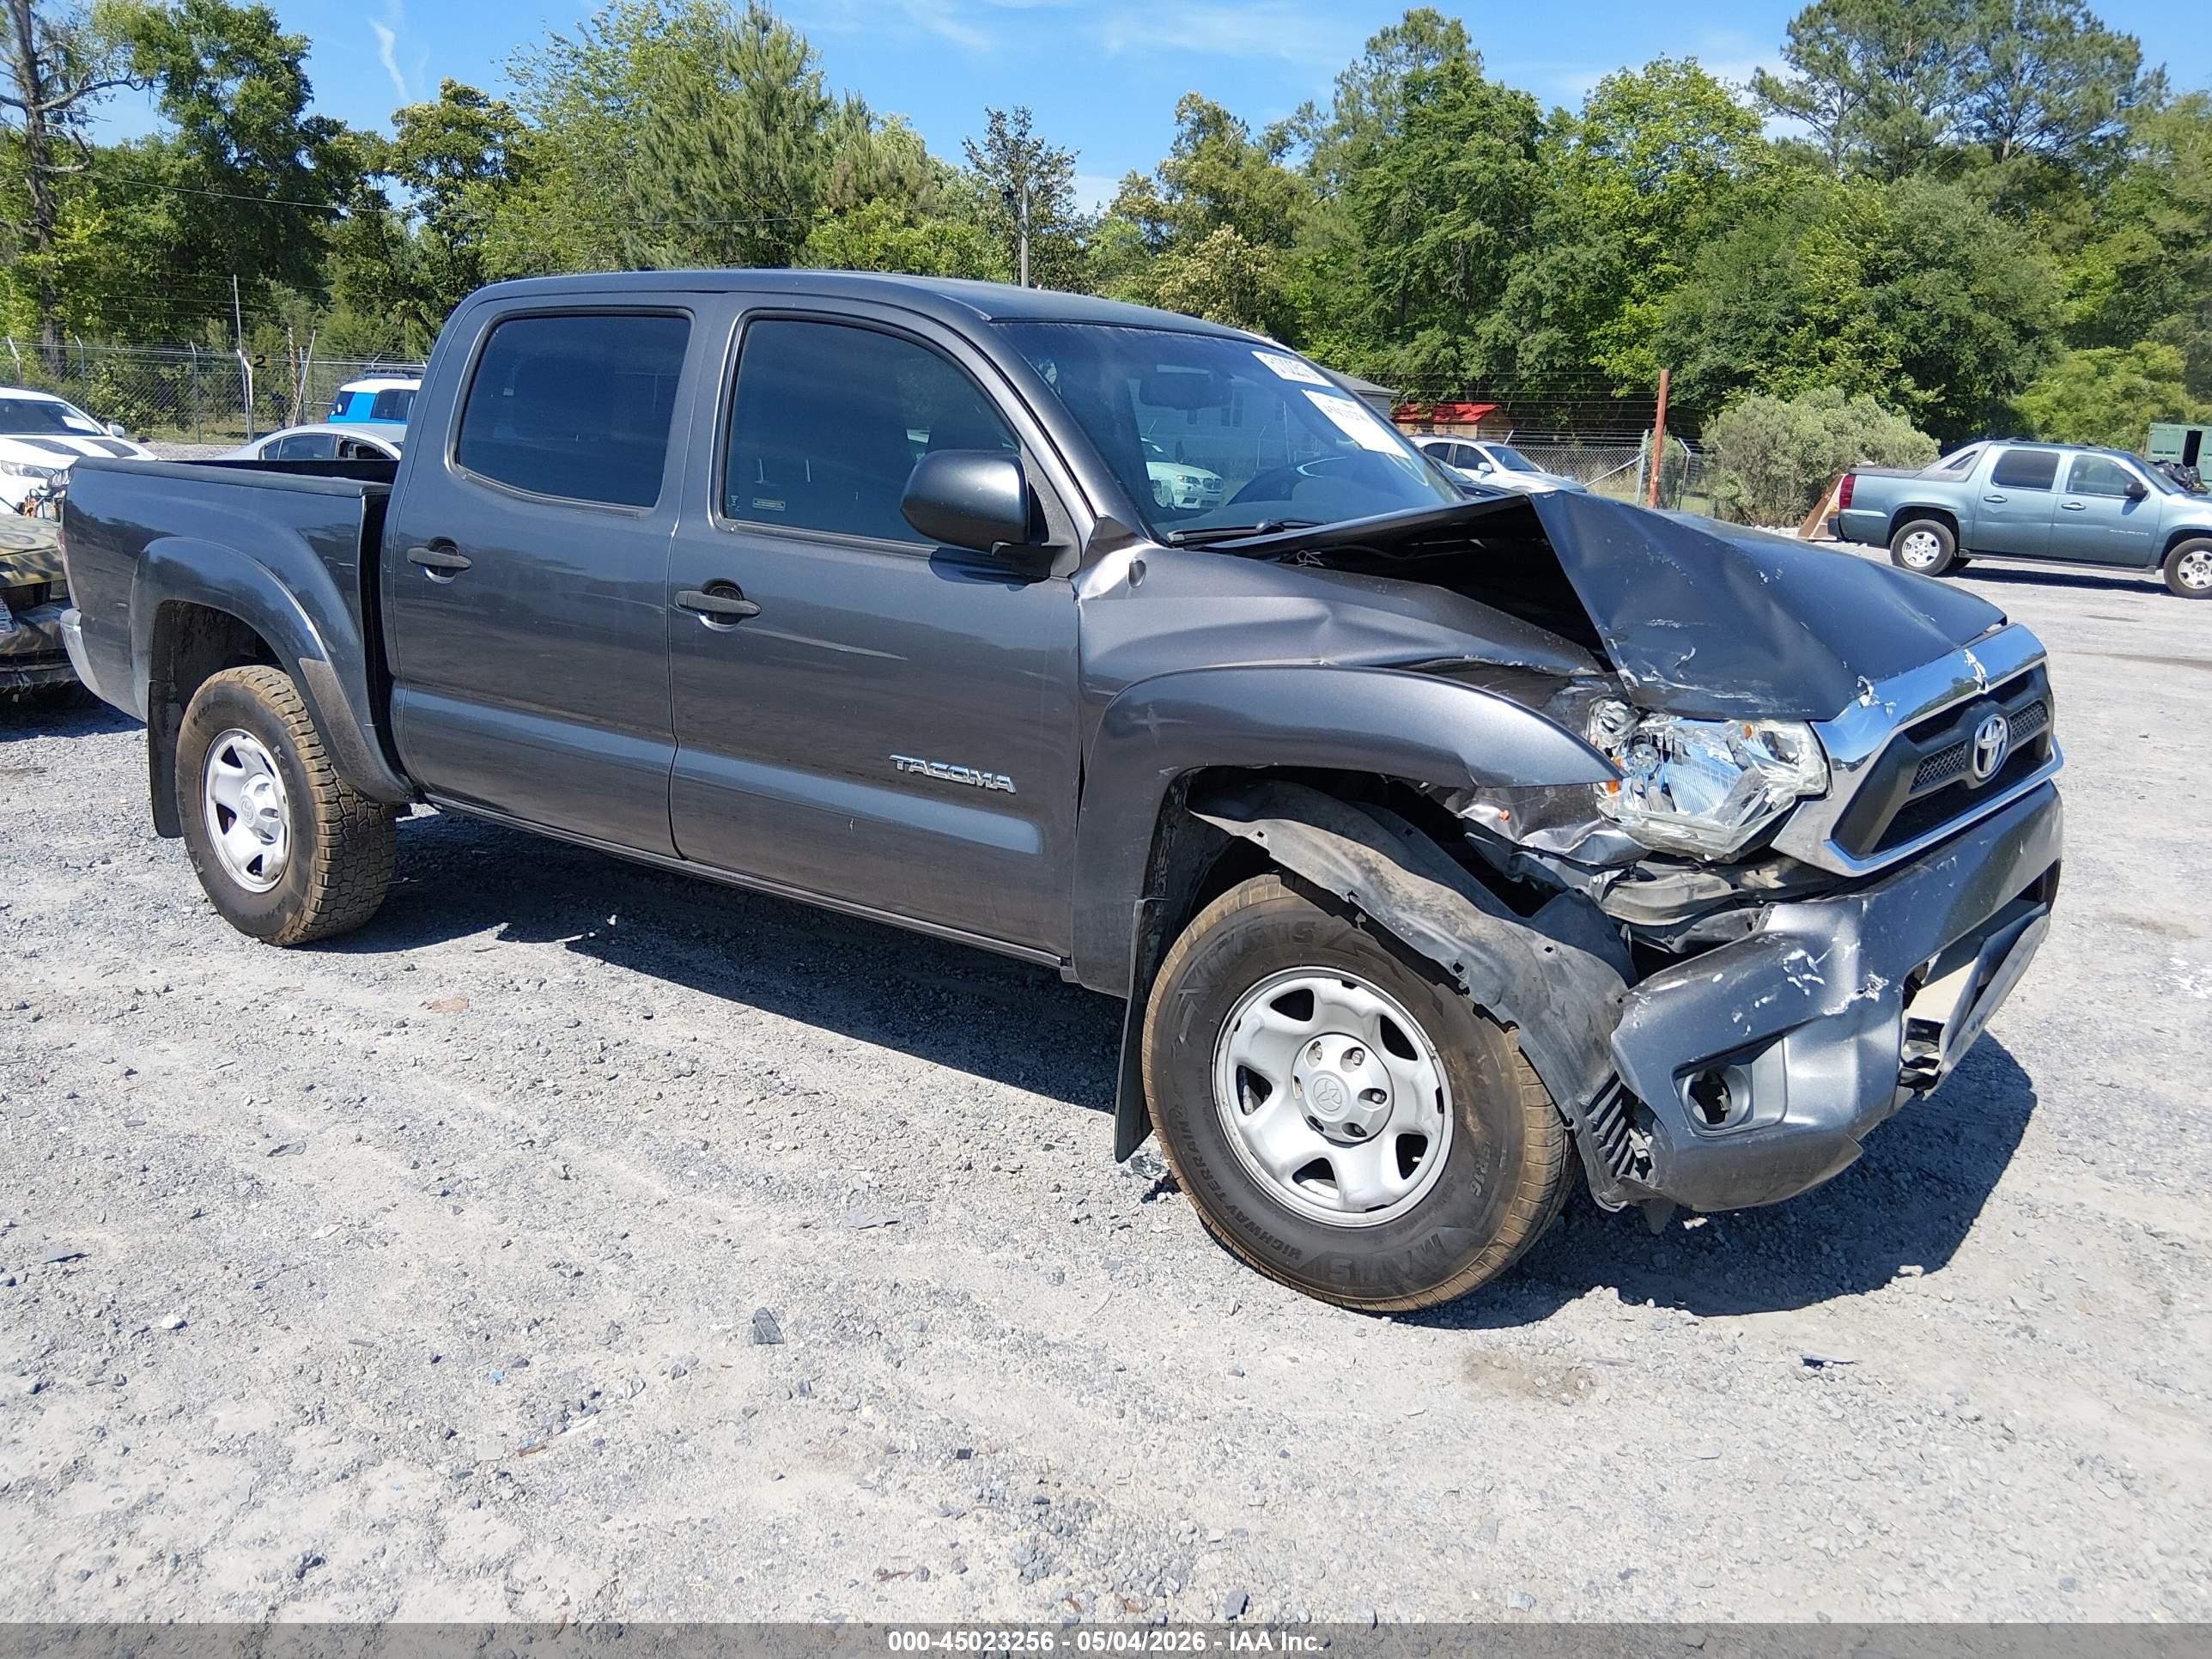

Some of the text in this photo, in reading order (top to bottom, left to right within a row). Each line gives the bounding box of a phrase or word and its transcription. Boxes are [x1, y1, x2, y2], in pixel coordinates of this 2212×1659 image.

[253, 355, 267, 368] 2
[889, 754, 1017, 794] TACOMA
[1180, 1121, 1304, 1261] HIGHWAY TERRAIN
